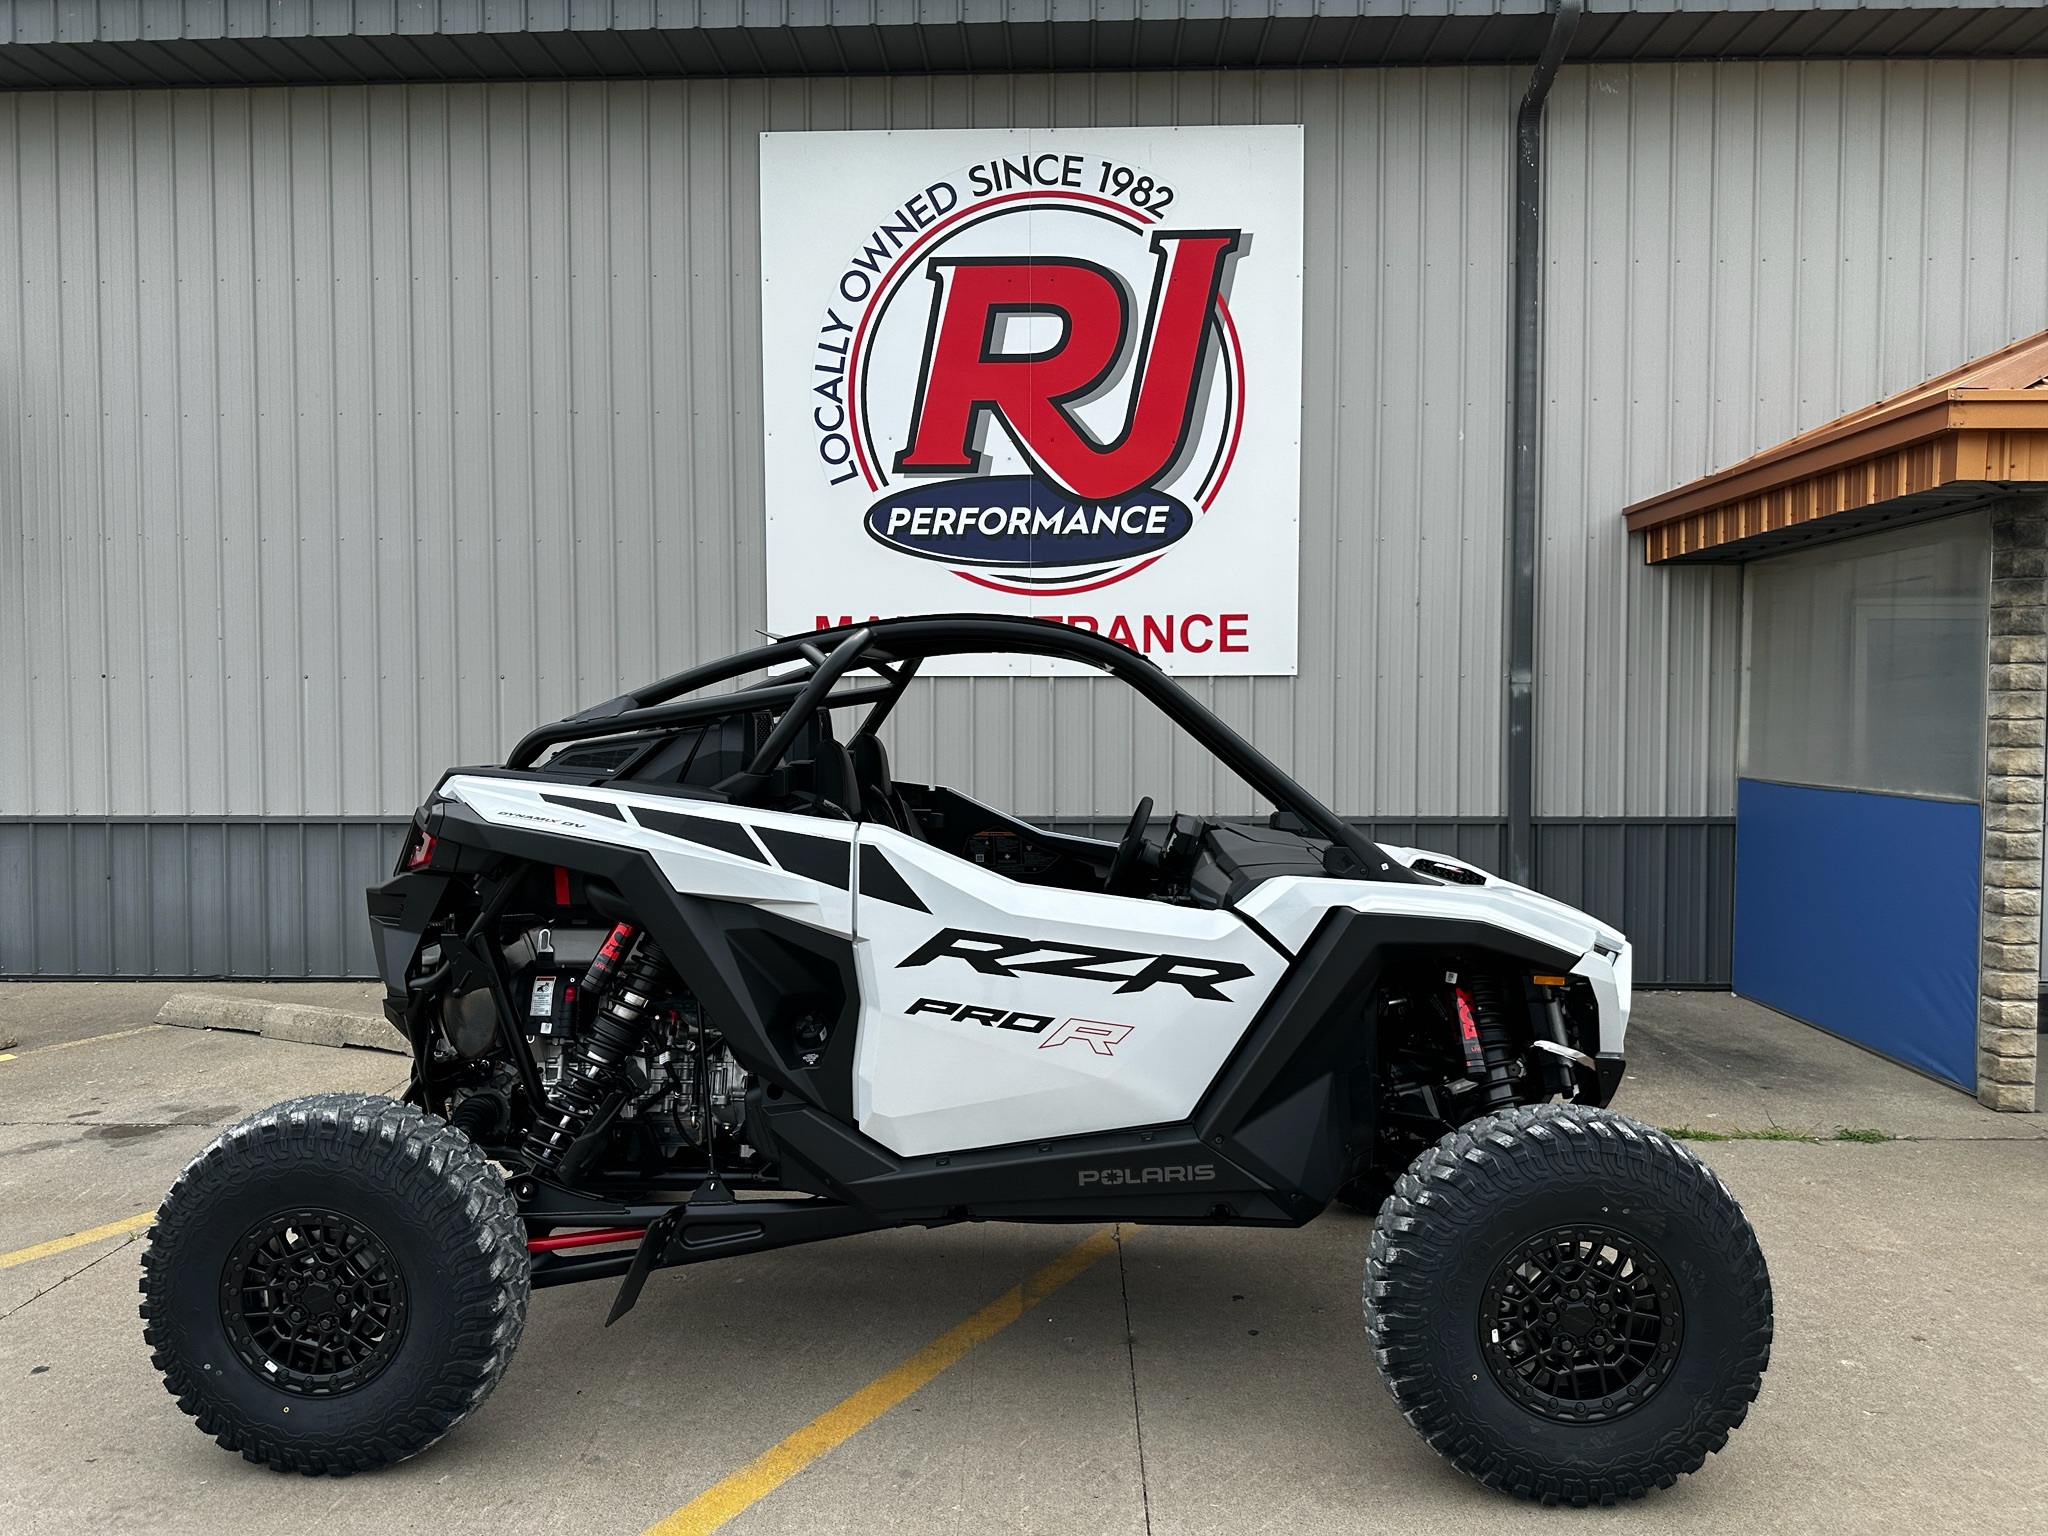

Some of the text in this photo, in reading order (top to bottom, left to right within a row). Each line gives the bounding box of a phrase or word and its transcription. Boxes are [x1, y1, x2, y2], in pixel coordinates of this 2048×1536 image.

[812, 154, 1174, 486] LOCALLY OWNED SINCE 1982
[892, 229, 1247, 505] RJ
[886, 504, 1171, 536] PERFORMANCE
[894, 927, 1255, 1003] RZR
[904, 997, 1135, 1057] PRO R
[1078, 1164, 1216, 1187] POLARIS
